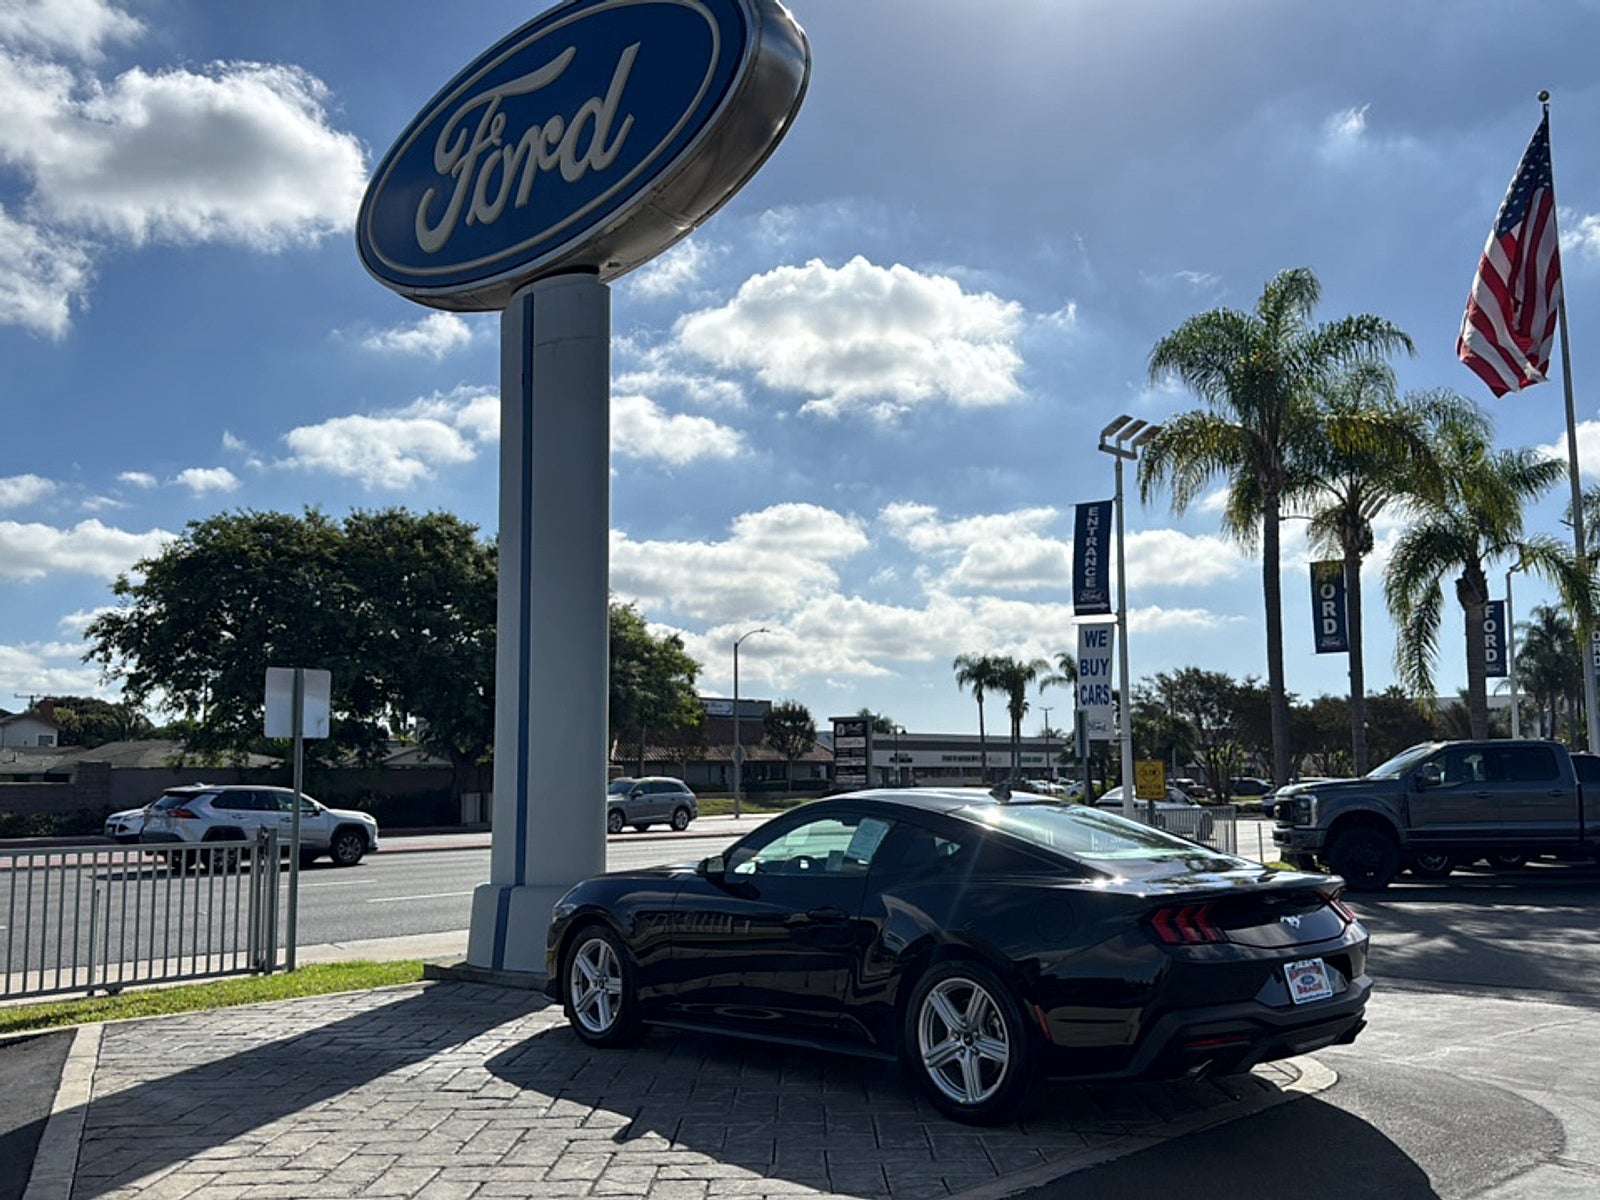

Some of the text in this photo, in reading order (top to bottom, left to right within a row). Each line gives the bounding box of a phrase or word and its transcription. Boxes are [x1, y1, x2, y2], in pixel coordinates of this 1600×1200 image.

[415, 41, 641, 254] Ford
[1084, 506, 1100, 588] ENTRANCE
[1319, 569, 1338, 635] ORD
[1084, 629, 1108, 648] WE
[1483, 604, 1498, 662] FORD
[1080, 658, 1110, 677] BUY
[1080, 685, 1110, 706] CARS
